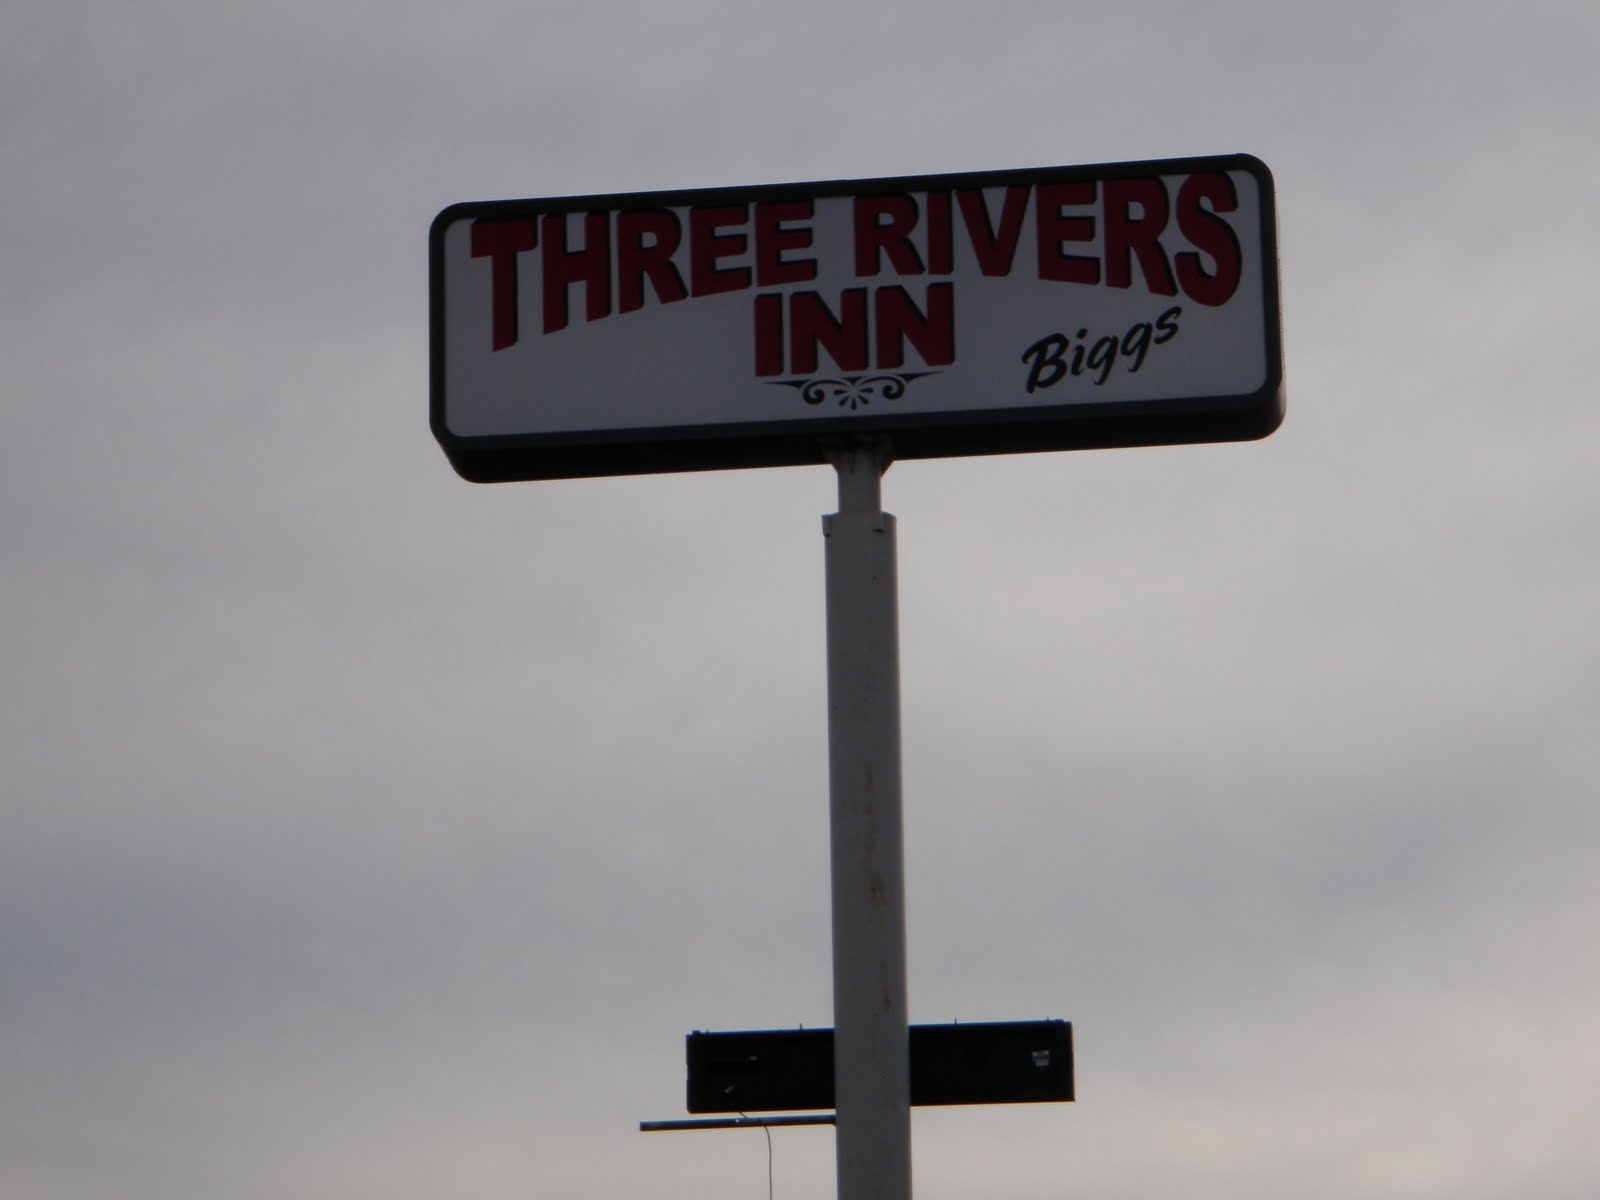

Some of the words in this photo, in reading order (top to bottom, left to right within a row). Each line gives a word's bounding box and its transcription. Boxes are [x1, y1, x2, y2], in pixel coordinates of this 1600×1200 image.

[470, 198, 818, 352] THREE
[854, 171, 1242, 307] RIVERS
[754, 283, 955, 377] INN
[1022, 306, 1182, 394] Biggs
